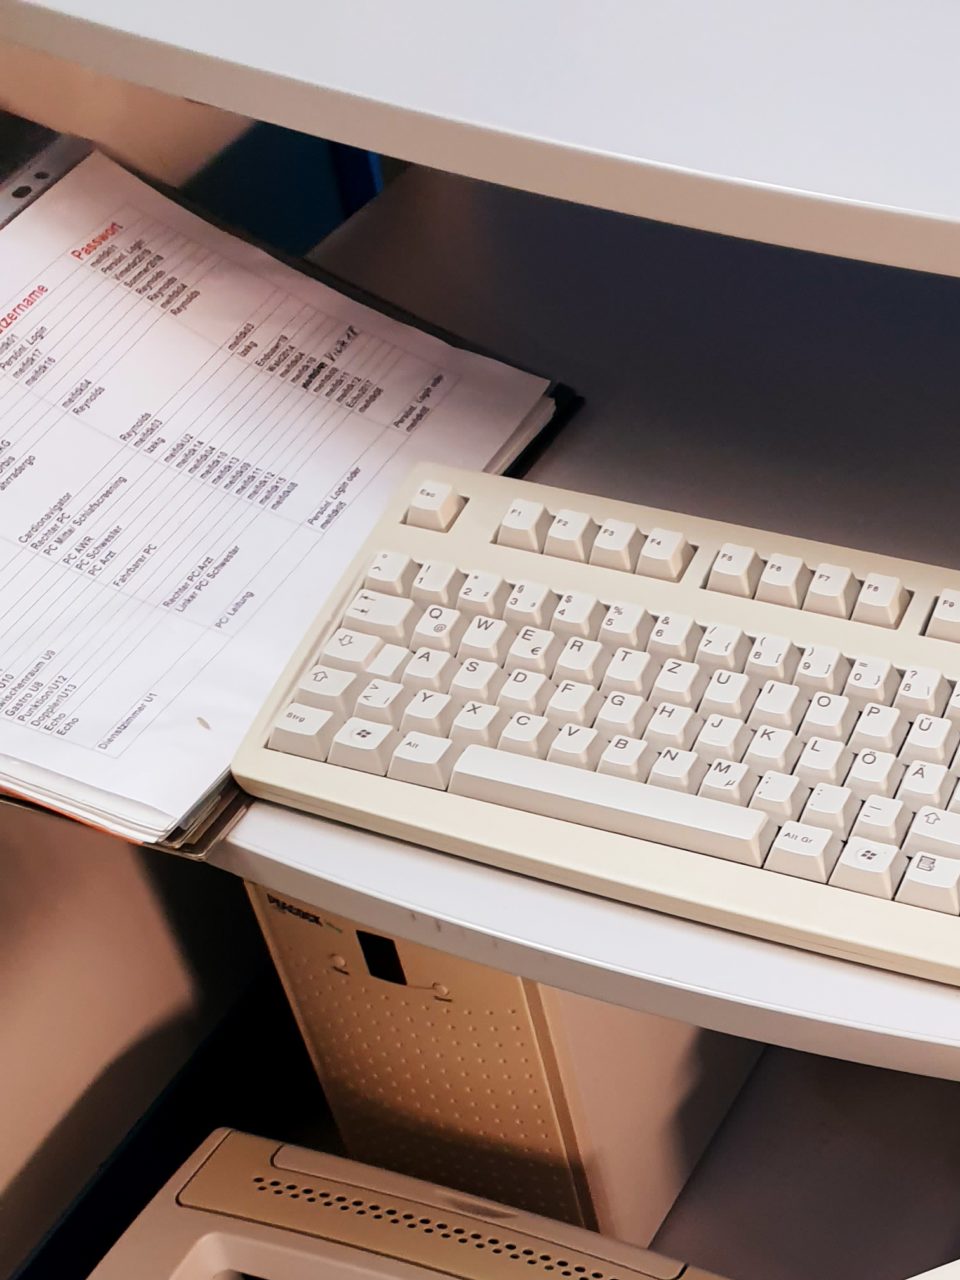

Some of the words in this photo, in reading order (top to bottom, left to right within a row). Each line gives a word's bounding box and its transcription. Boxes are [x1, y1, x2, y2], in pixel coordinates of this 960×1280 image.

[71, 221, 124, 261] Passwort
[429, 608, 442, 619] Q
[477, 618, 494, 630] W
[606, 618, 614, 626] 5
[522, 629, 534, 641] E
[656, 629, 664, 637] 6
[570, 640, 583, 652] R
[704, 639, 712, 647] 7
[418, 652, 430, 662] A
[621, 651, 632, 661] T
[753, 651, 762, 659] 8
[466, 662, 479, 672] S
[667, 662, 681, 674] Z
[803, 662, 811, 670] 9
[513, 672, 527, 682] D
[717, 673, 731, 684] U
[854, 673, 862, 681] 0
[561, 683, 575, 692] F
[422, 692, 433, 702] Y
[611, 695, 625, 706] G
[817, 696, 831, 707] O
[466, 704, 479, 714] X
[659, 707, 675, 718] H
[867, 707, 880, 716] P
[517, 716, 530, 725] C
[711, 719, 723, 728] J
[919, 717, 932, 731] Ü
[568, 726, 580, 736] V
[760, 729, 774, 740] K
[615, 739, 628, 749] B
[811, 741, 820, 752] L
[663, 750, 678, 761] N
[862, 751, 876, 764] Ö
[714, 762, 731, 773] M
[912, 764, 925, 778] Ä
